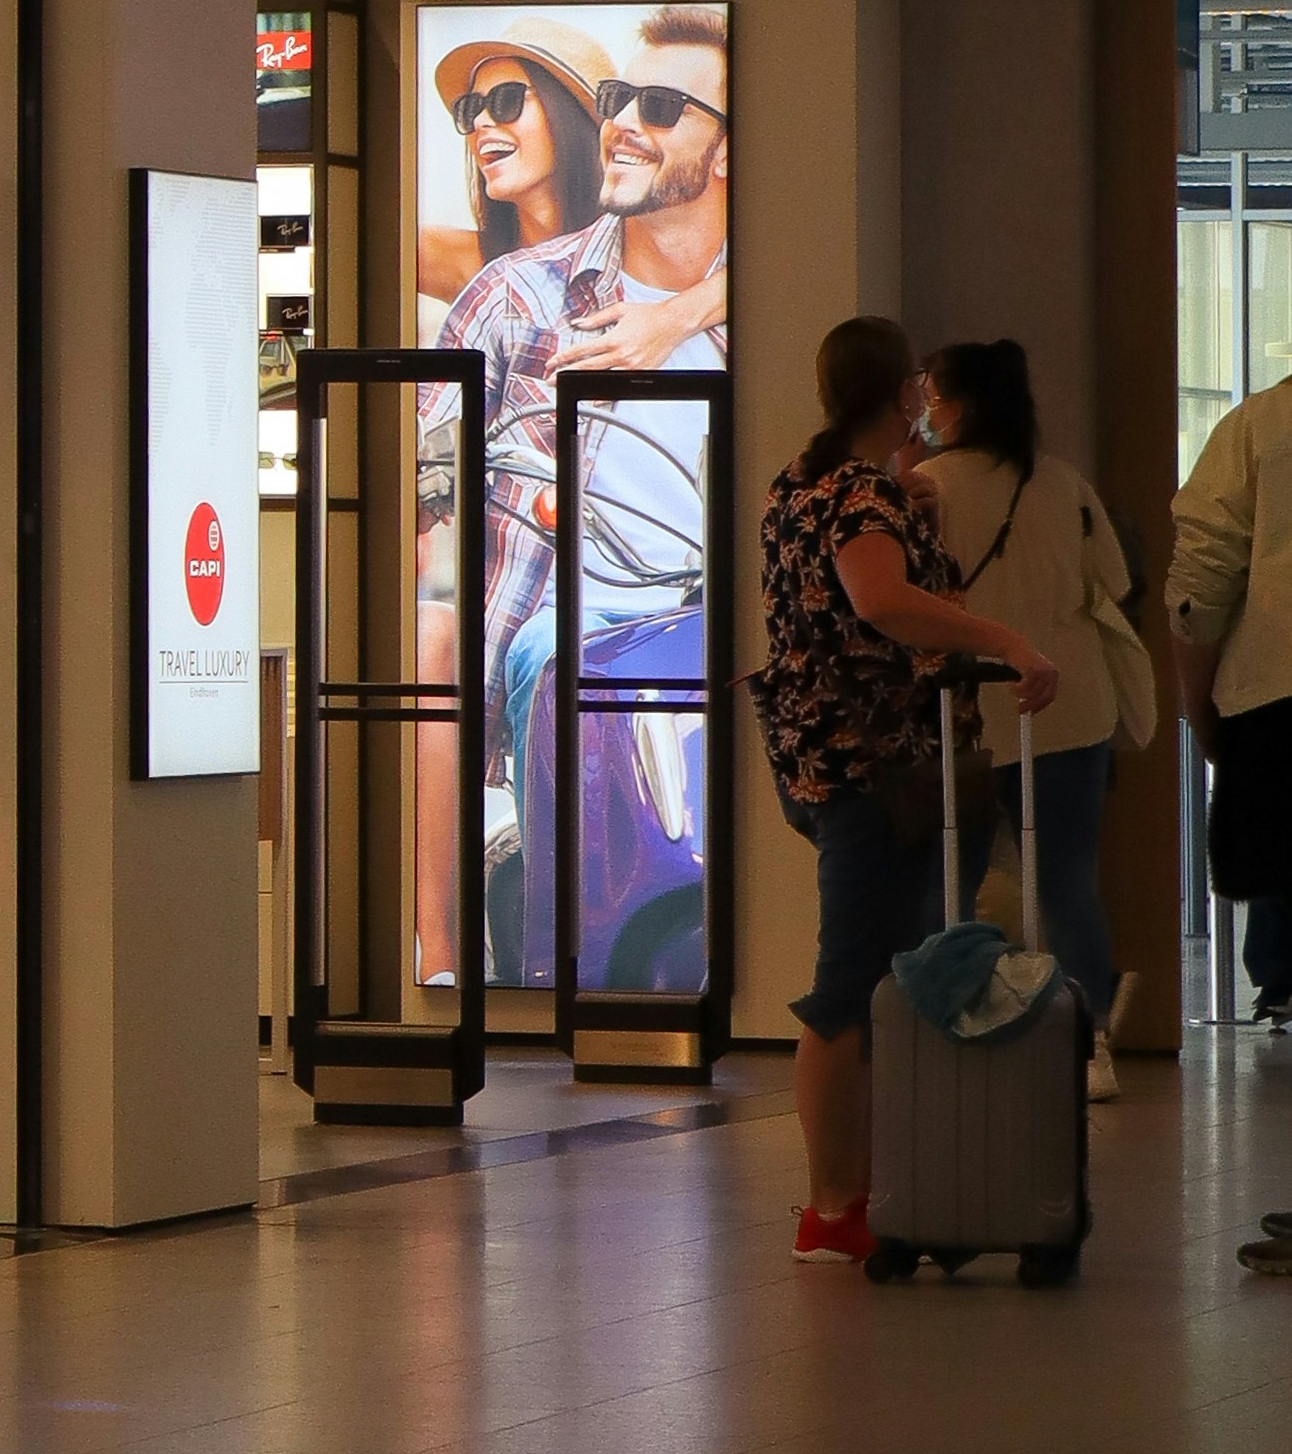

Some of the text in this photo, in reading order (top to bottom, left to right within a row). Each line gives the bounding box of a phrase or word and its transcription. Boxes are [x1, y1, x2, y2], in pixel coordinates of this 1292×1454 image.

[189, 560, 221, 577] CAPI
[159, 650, 250, 678] TRAVEL LUXURY
